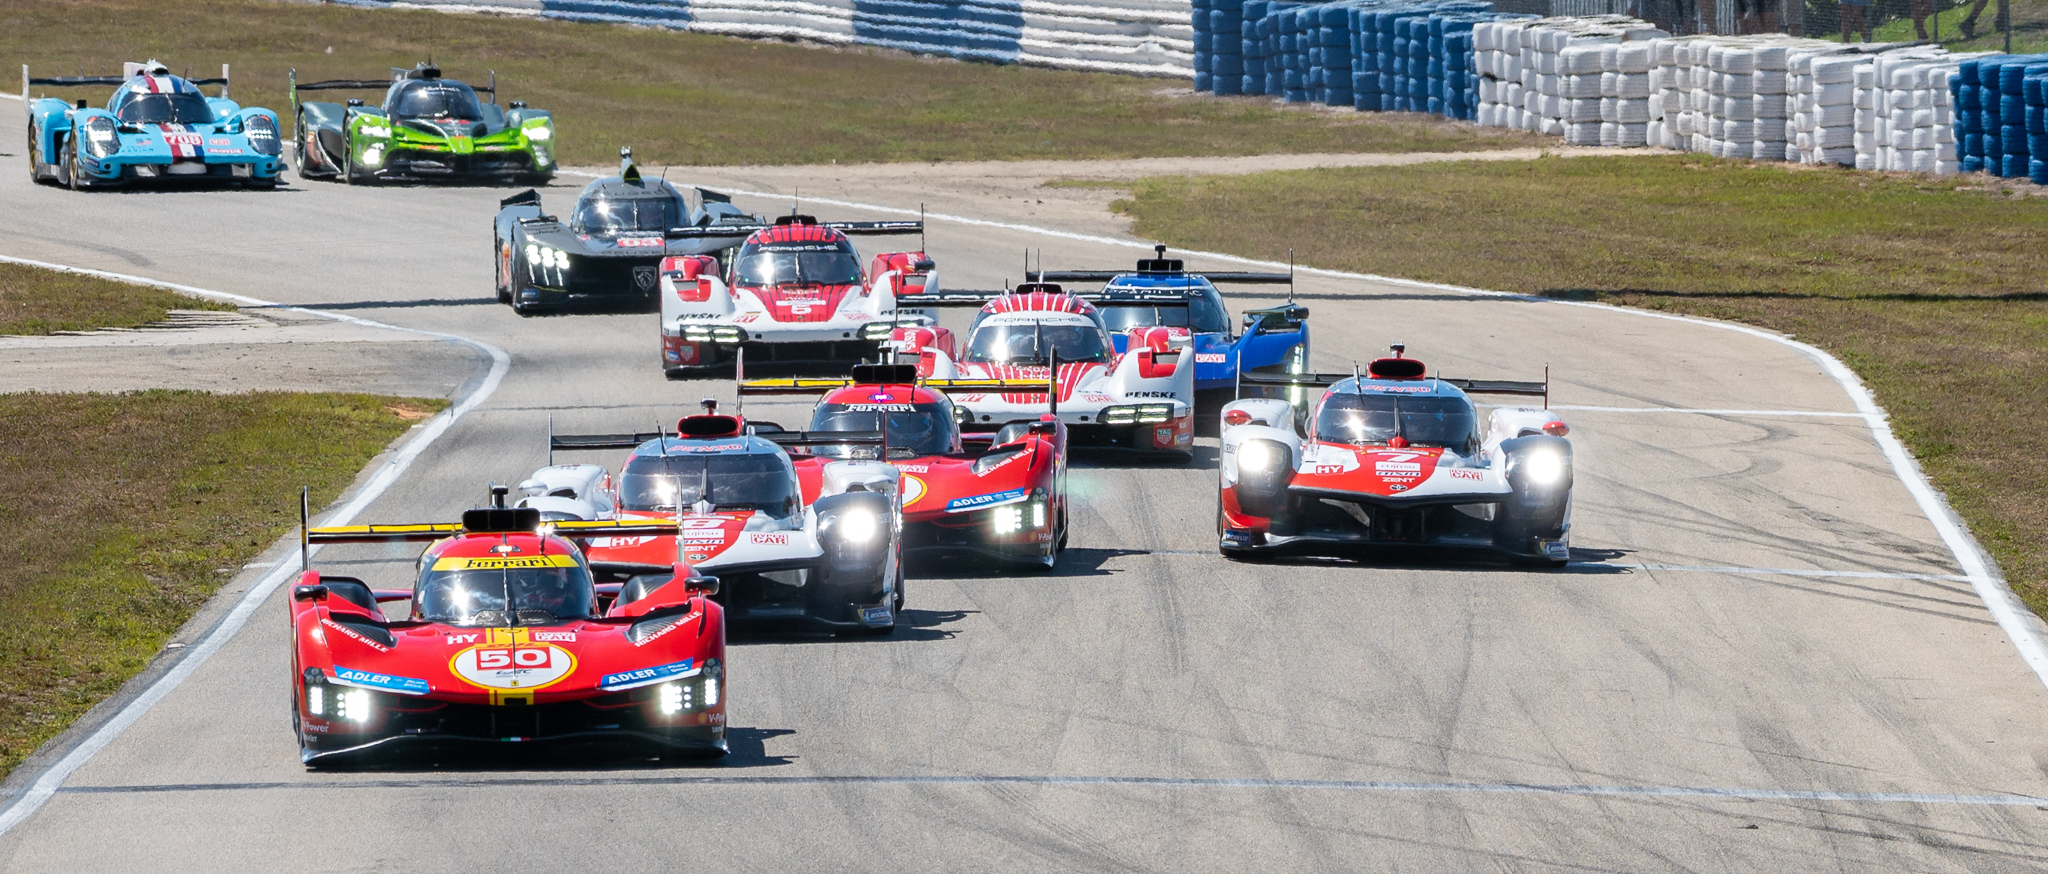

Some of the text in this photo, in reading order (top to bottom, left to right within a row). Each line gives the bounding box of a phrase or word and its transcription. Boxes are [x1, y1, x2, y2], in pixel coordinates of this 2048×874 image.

[791, 304, 812, 315] 5
[1125, 391, 1177, 399] PENSKE
[845, 403, 917, 412] Ferrari
[670, 444, 743, 452] DENSO
[1377, 452, 1420, 461] 7
[1317, 466, 1341, 474] HY
[1452, 472, 1481, 480] CAR
[952, 494, 994, 507] ADLER
[612, 537, 639, 546] HY
[465, 558, 550, 569] Ferrari
[634, 611, 702, 647] RICHARD MILLE
[320, 618, 389, 653] RICHARD MILLE
[447, 634, 478, 645] HY
[480, 649, 548, 668] 50
[339, 671, 391, 684] ADLER
[608, 669, 657, 684] ADLER
